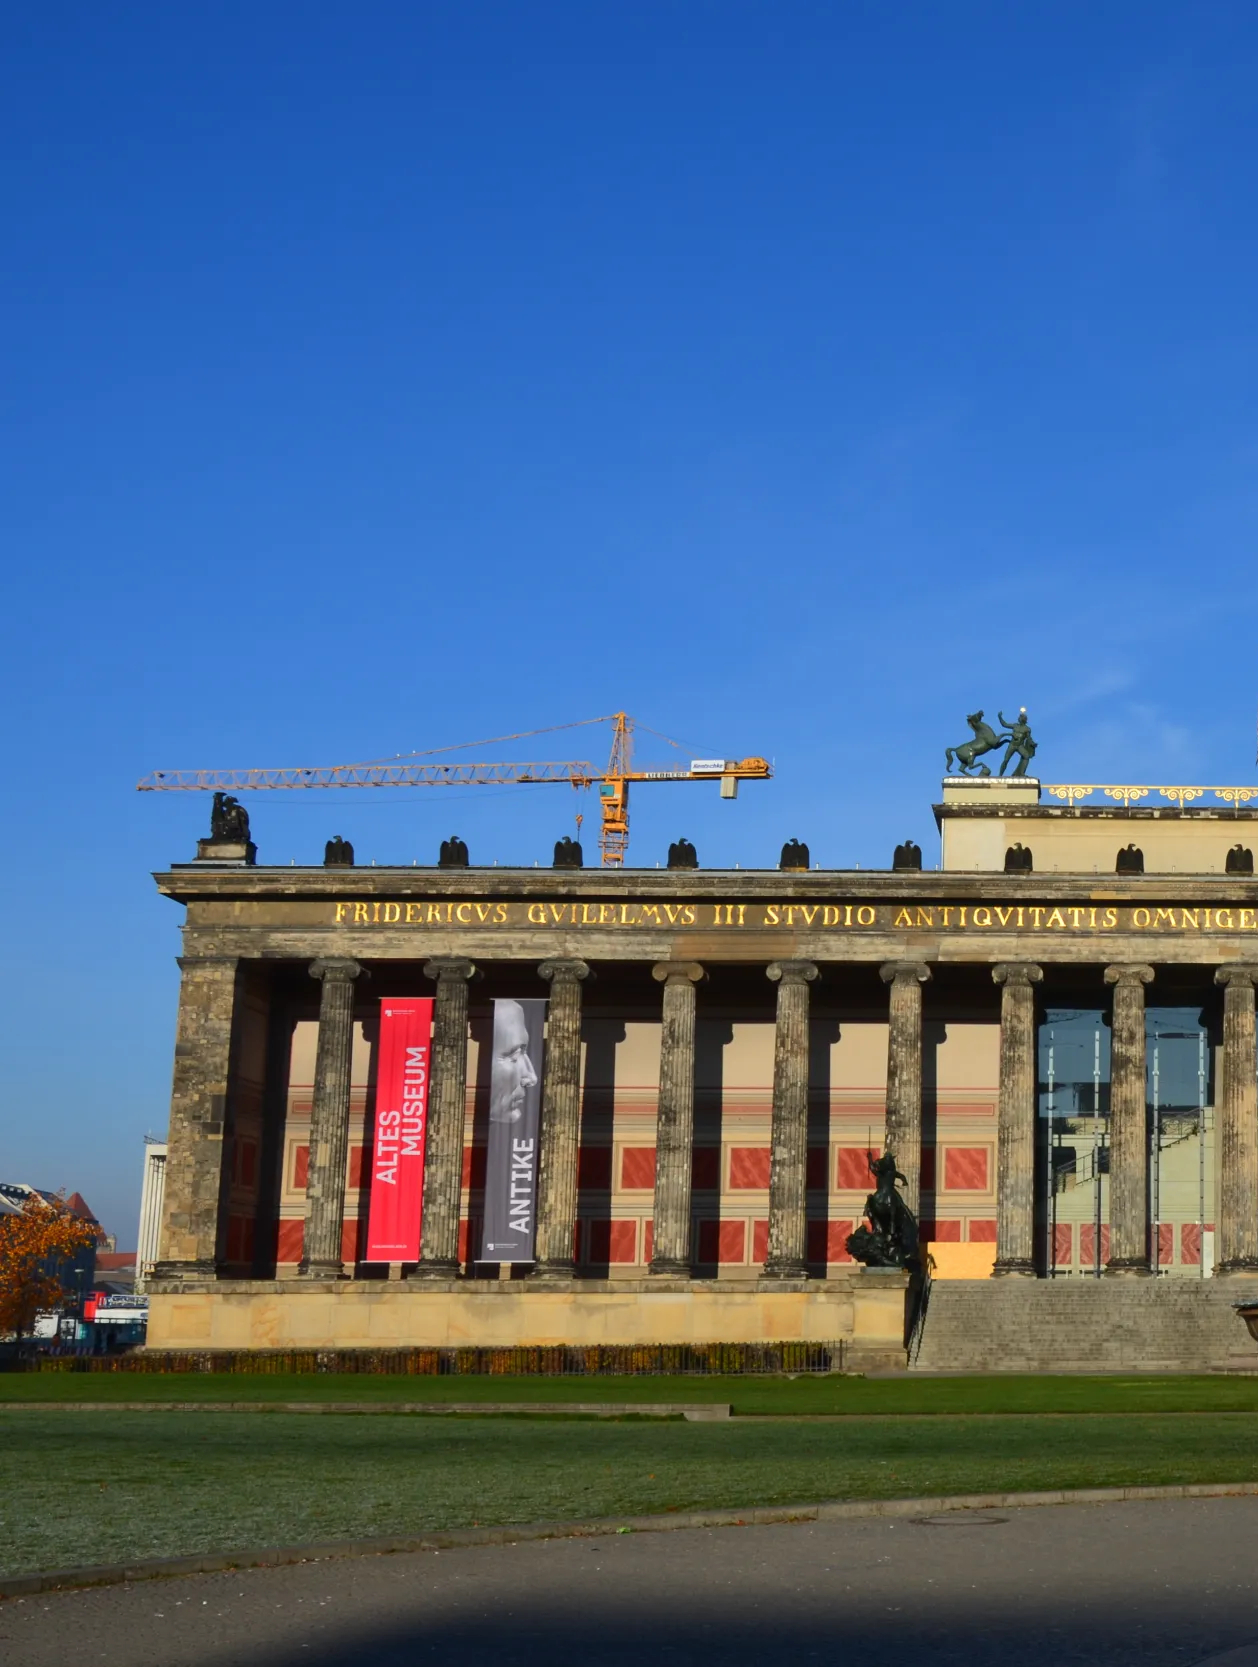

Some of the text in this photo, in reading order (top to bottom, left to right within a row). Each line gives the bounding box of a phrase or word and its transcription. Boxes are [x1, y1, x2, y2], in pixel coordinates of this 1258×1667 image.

[335, 902, 510, 924] FRIDERICVS
[527, 903, 697, 925] GVILELMVS
[713, 904, 747, 926] III
[763, 904, 876, 927] STVDIO
[893, 906, 1119, 930] ANTIQVITATIS
[400, 1046, 427, 1156] MUSEUM
[376, 1110, 401, 1185] ALTES
[508, 1137, 534, 1234] ANTIKE
